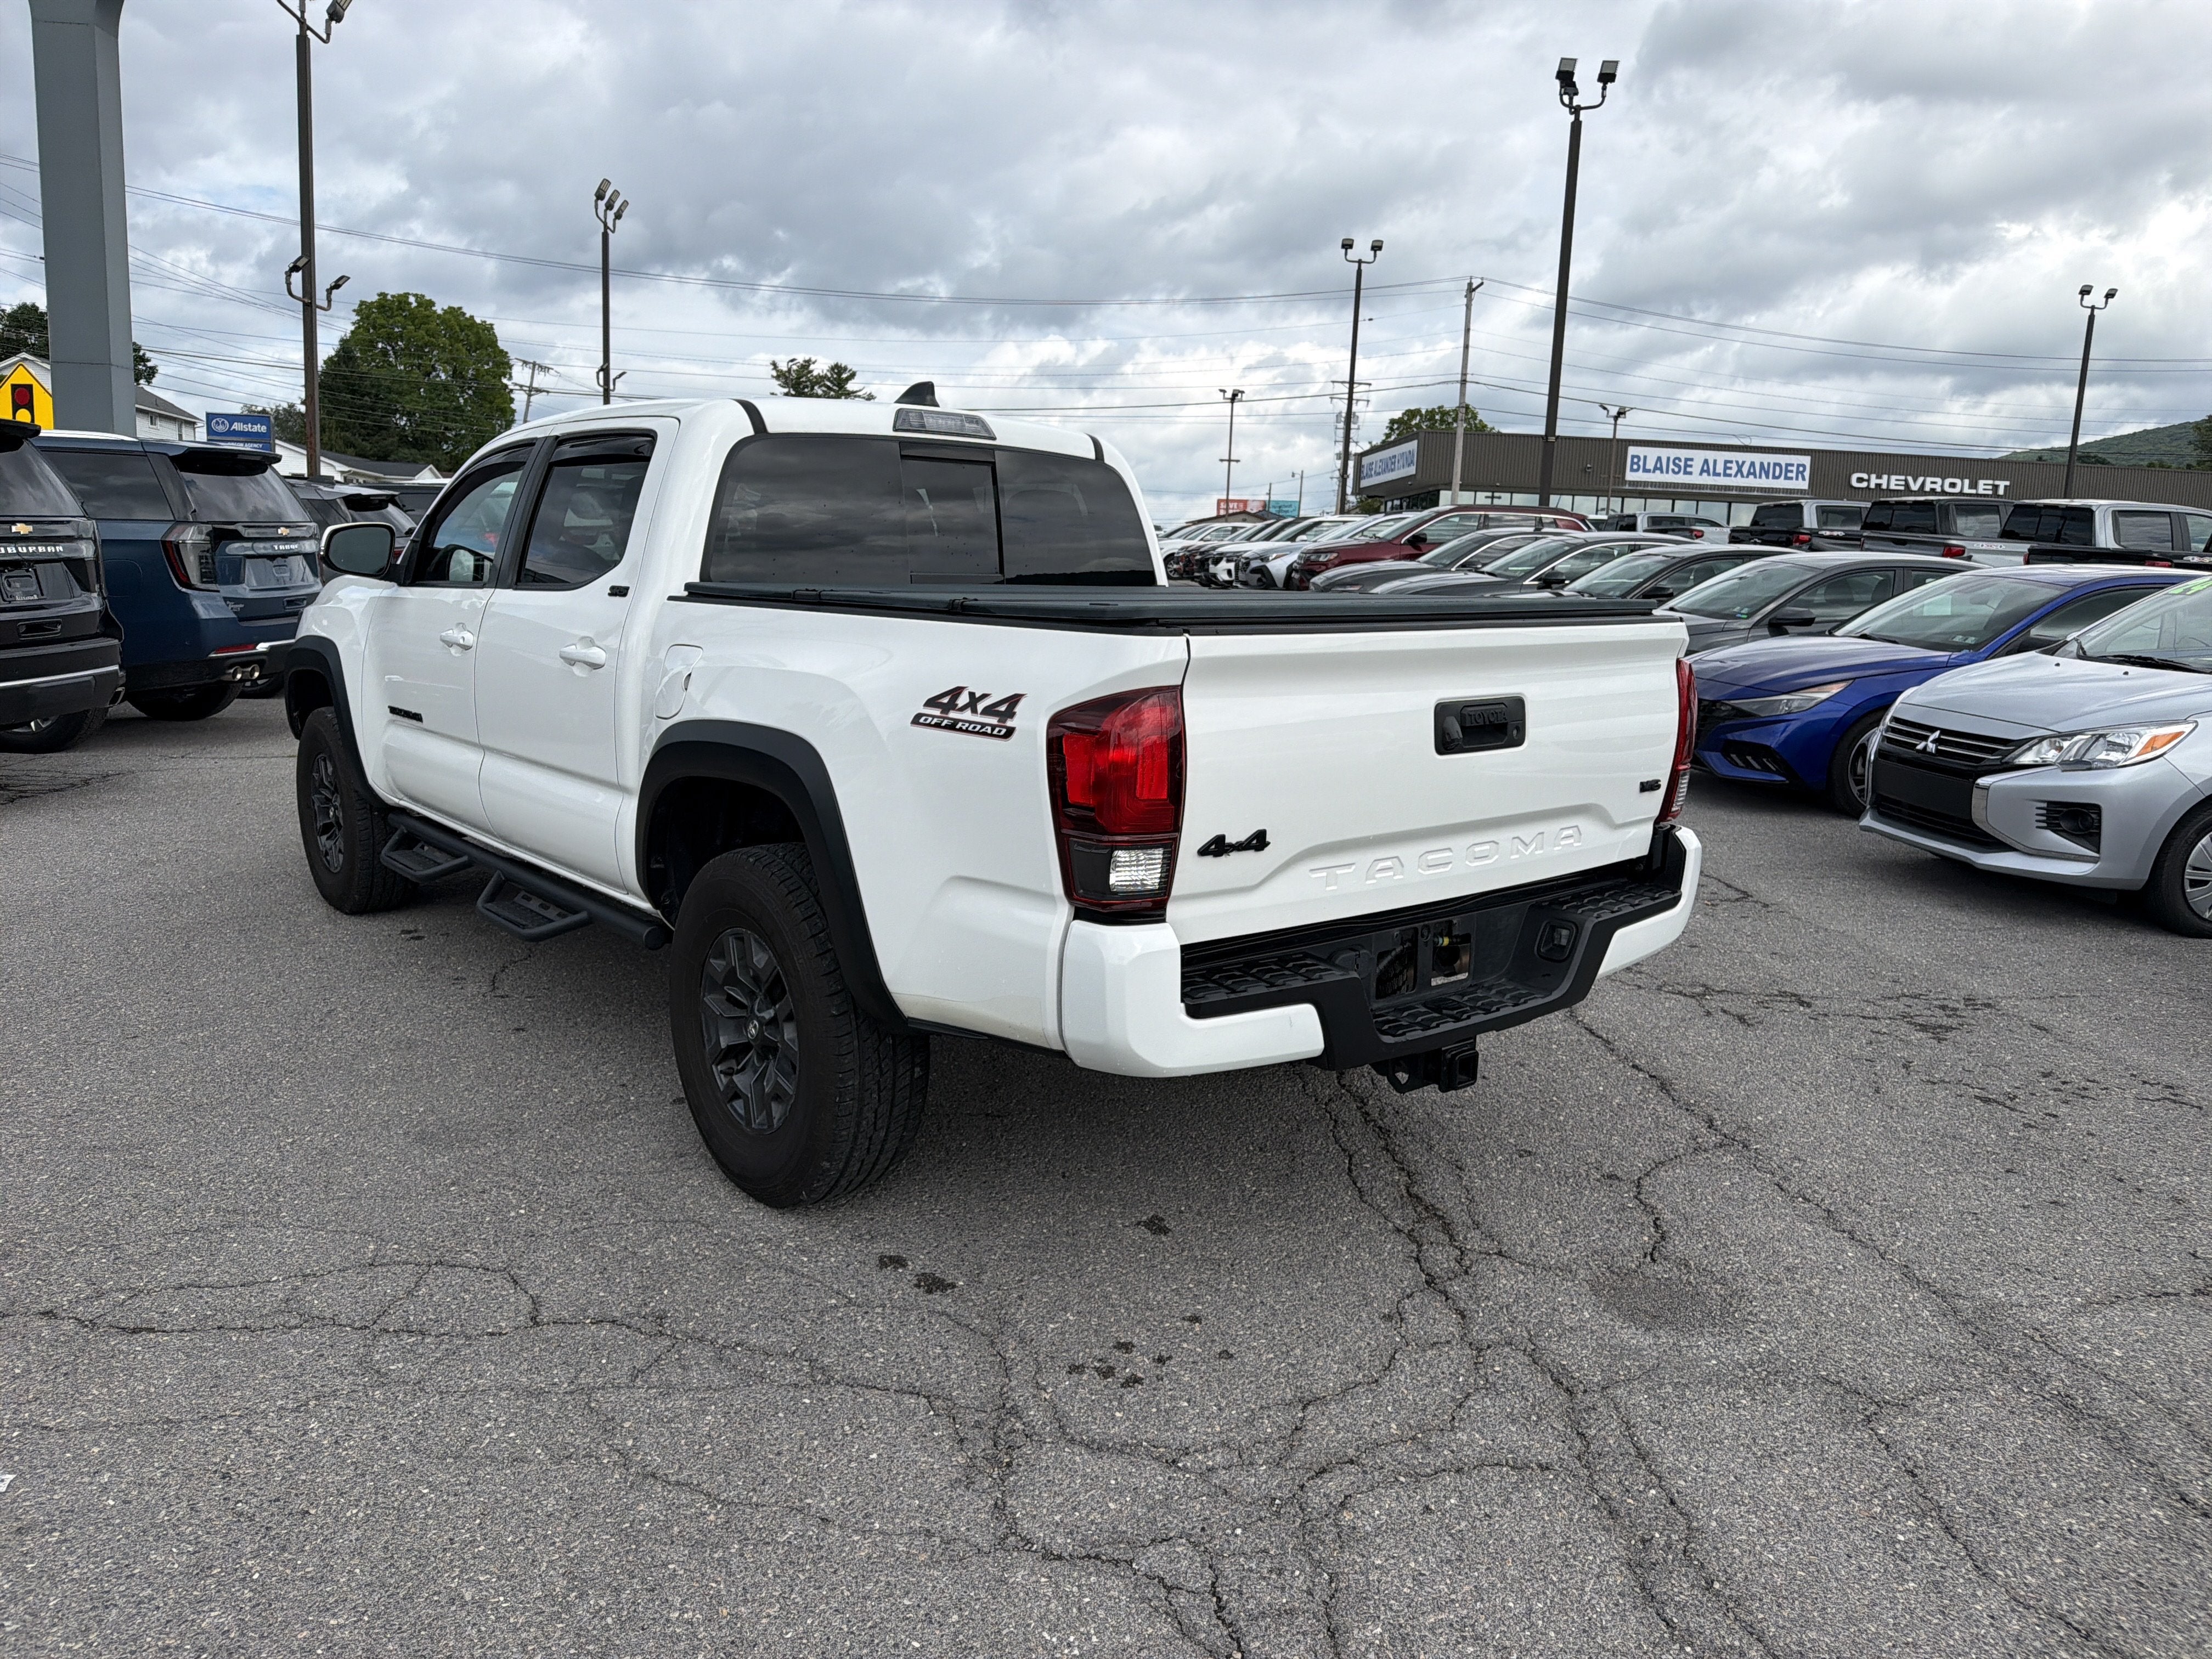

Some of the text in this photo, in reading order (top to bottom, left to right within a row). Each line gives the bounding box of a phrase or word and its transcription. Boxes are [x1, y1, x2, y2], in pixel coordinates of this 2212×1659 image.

[230, 422, 267, 432] Allstate
[1629, 454, 1807, 482] BLAISE ALEXANDER
[1850, 472, 2010, 495] CHEVROLET
[919, 716, 1007, 736] OFF ROAD
[1467, 710, 1508, 725] TOYOTA
[1309, 825, 1582, 890] TACOMA
